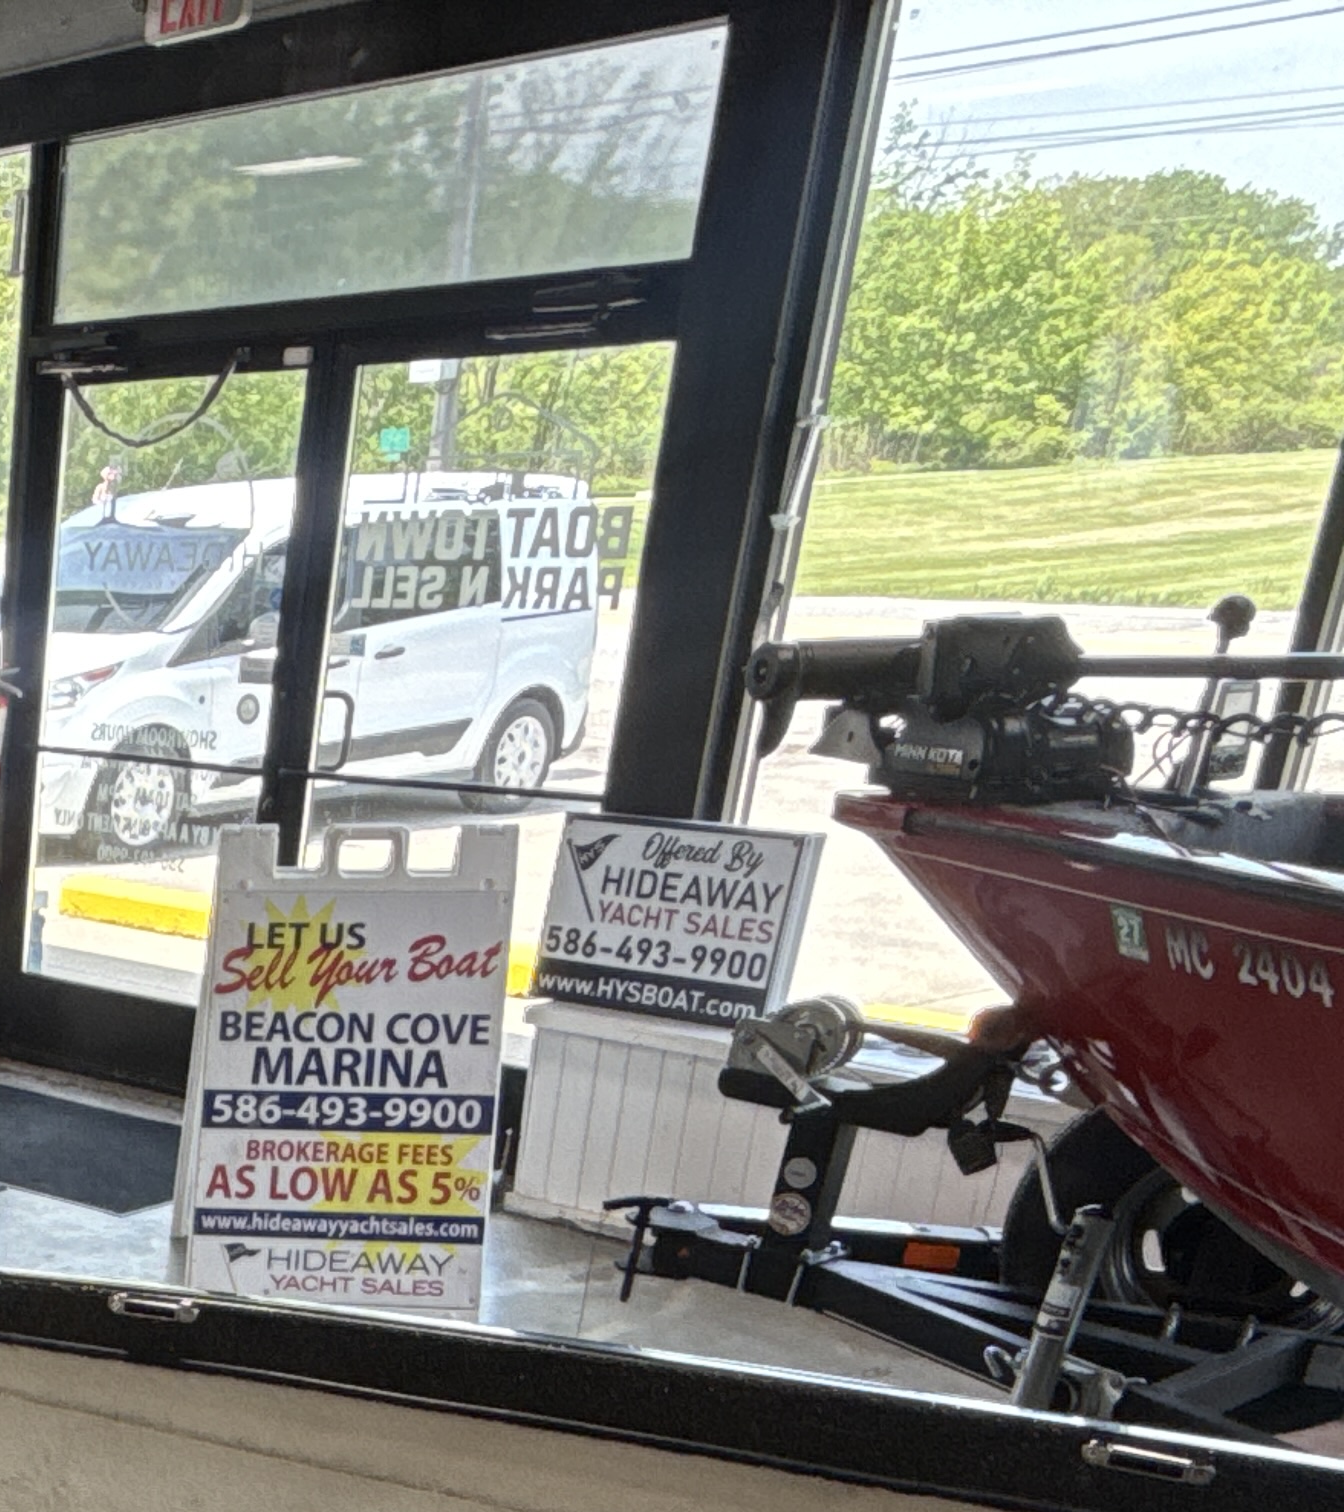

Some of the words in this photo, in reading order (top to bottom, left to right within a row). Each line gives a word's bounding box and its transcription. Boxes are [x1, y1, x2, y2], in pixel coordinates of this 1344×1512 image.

[641, 832, 721, 868] Offered
[724, 840, 764, 878] By
[600, 865, 785, 914] HIDEAWAY
[246, 922, 310, 951] LET
[319, 922, 367, 950] US
[597, 899, 682, 933] YACHT
[683, 911, 776, 944] SALES
[214, 946, 297, 996] Sell
[307, 943, 397, 1008] Your
[407, 934, 505, 984] Boat
[544, 925, 768, 983] 586-493-9900
[1164, 925, 1215, 981] MC
[1232, 940, 1335, 1008] 2404
[538, 972, 757, 1021] www.HYSBOAT.com
[219, 1010, 375, 1045] BEACON
[386, 1012, 492, 1046] COVE
[250, 1046, 448, 1089] MARINA
[210, 1093, 483, 1130] 586-493-9900
[246, 1139, 390, 1165] BROKERAGE
[398, 1143, 454, 1166] FEES
[205, 1164, 255, 1200] AS
[269, 1165, 359, 1203] LOW
[367, 1168, 420, 1204] AS
[430, 1171, 481, 1204] 5%
[200, 1211, 479, 1240] www.hideawayyachtsales.com
[265, 1248, 455, 1278] HIDEAWAY
[268, 1274, 355, 1295] YACHT
[361, 1276, 445, 1297] SALES
